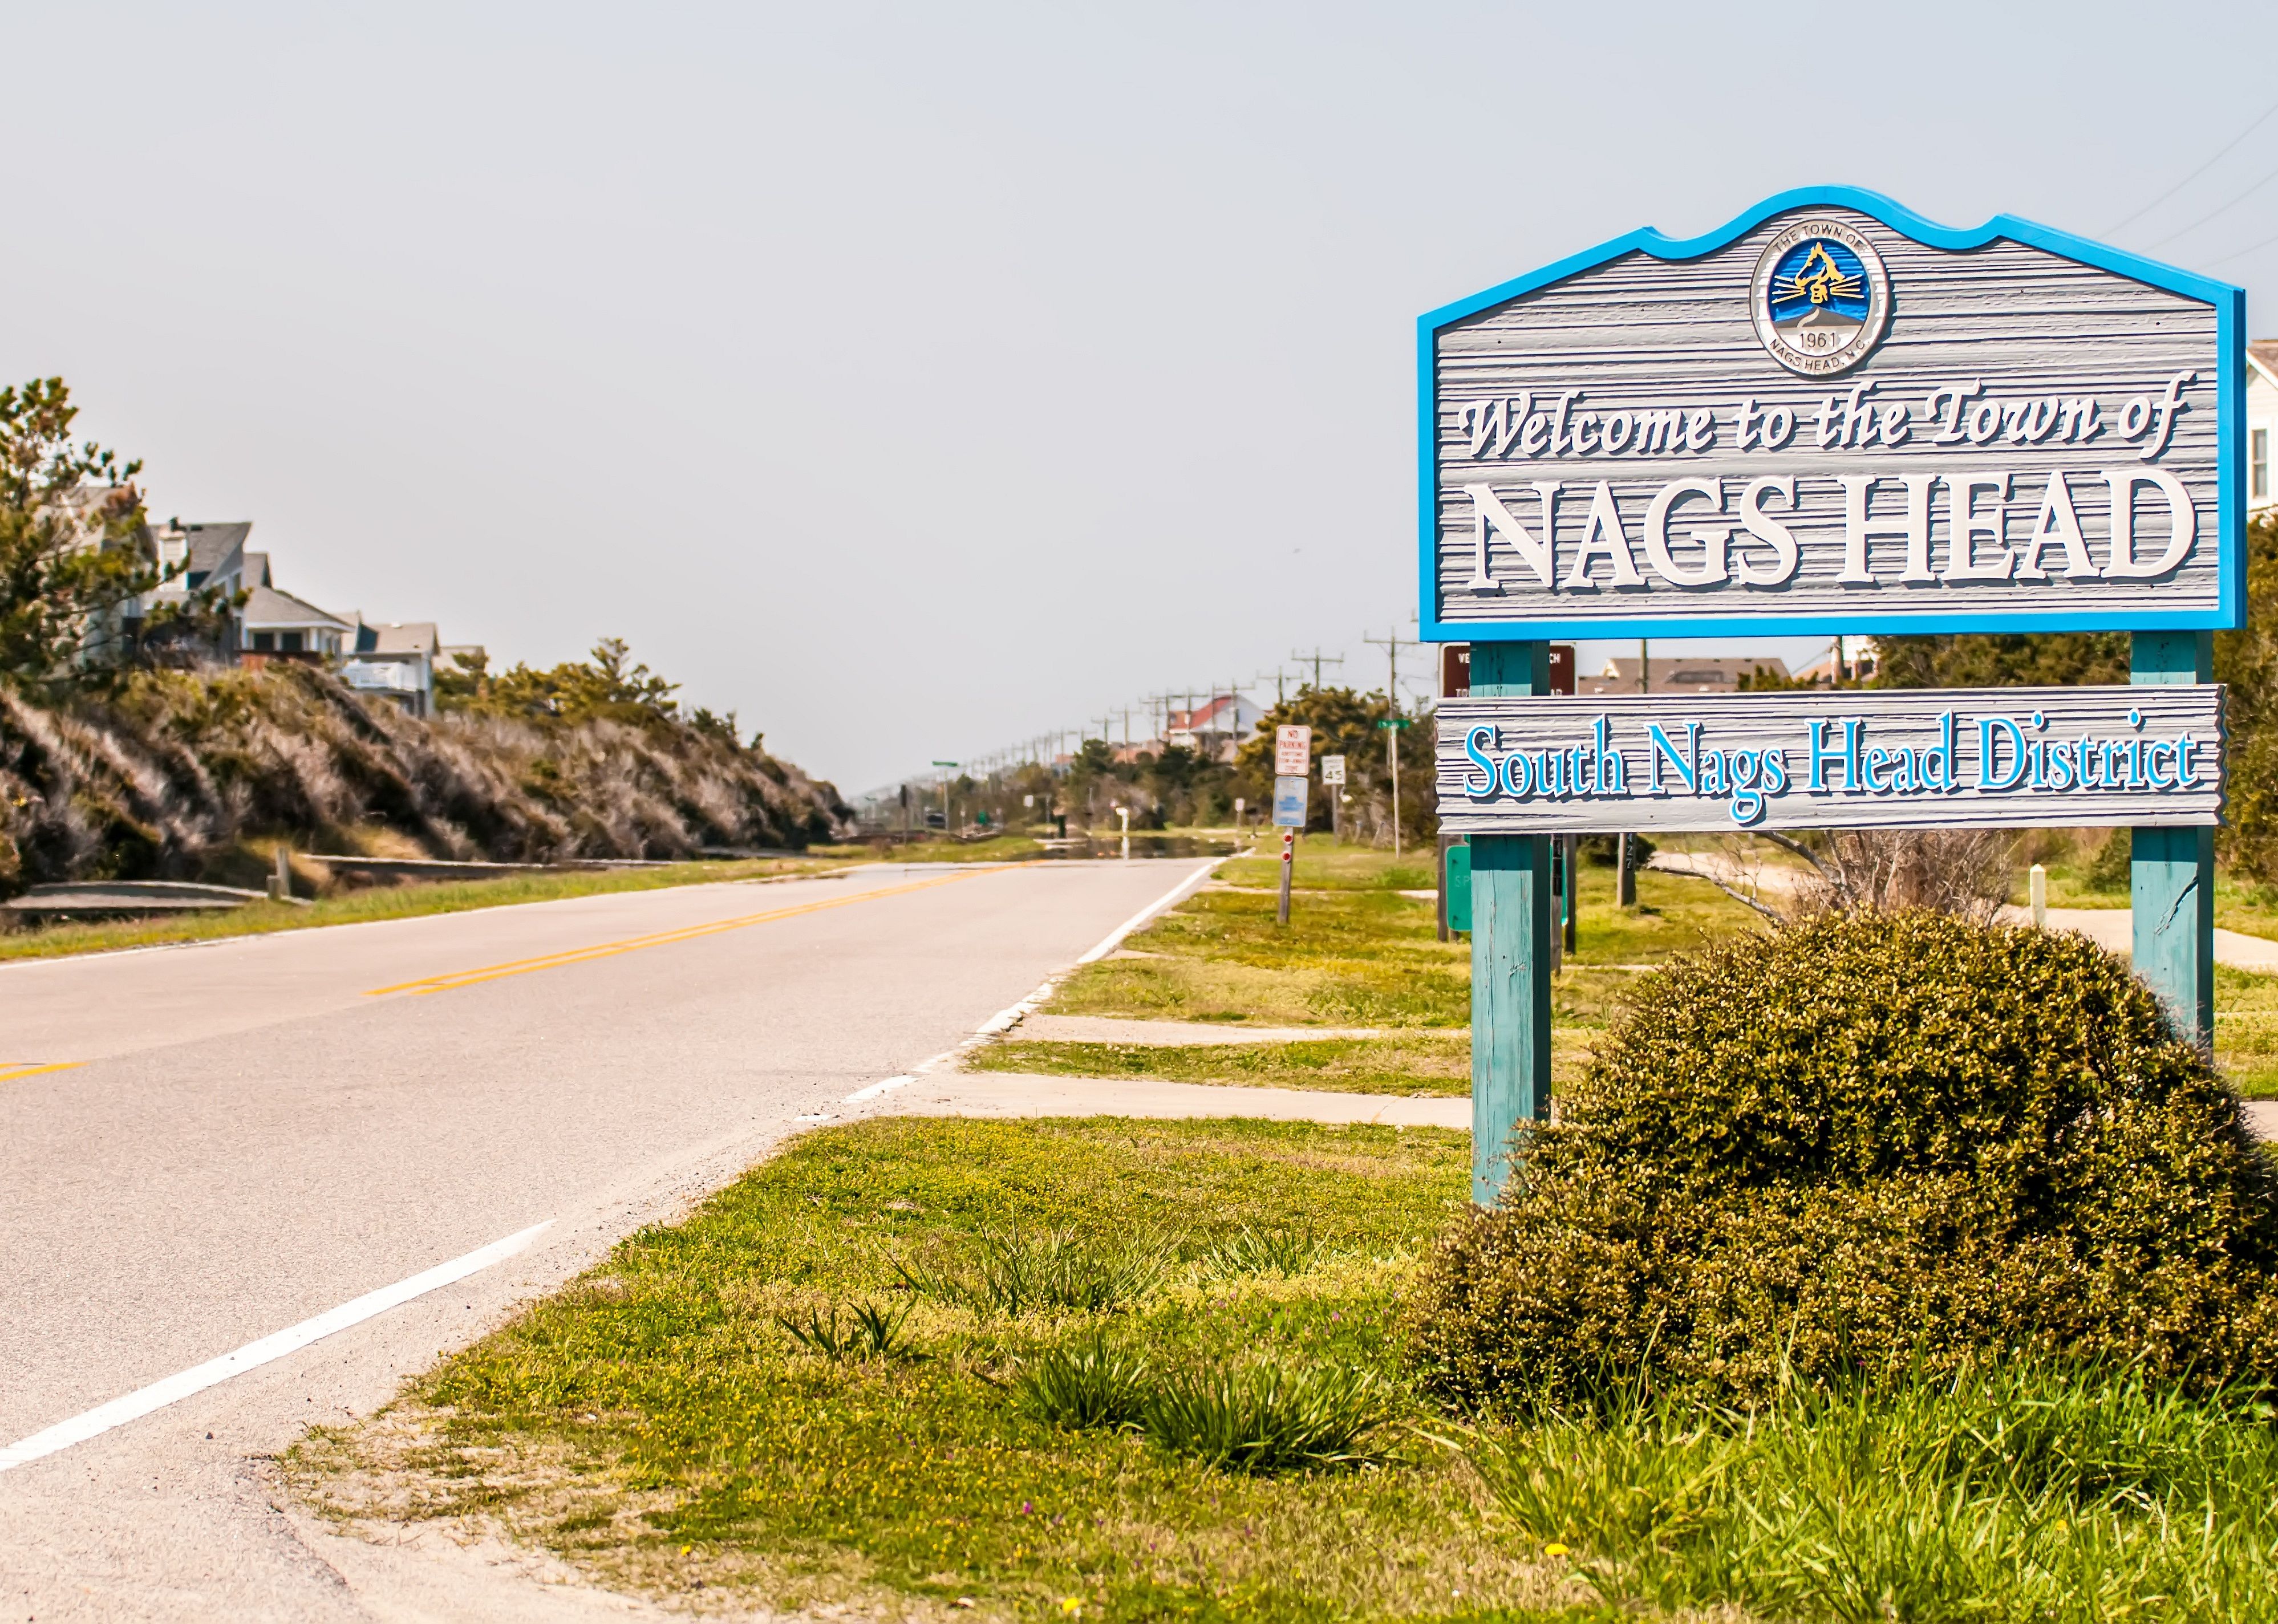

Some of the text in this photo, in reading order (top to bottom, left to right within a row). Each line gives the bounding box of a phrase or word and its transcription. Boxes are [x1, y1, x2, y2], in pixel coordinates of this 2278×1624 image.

[1773, 224, 1865, 252] THE TOWN OF
[1770, 338, 1802, 367] NAGS
[1805, 356, 1845, 371] HEAD,
[1799, 332, 1837, 348] 1961
[1457, 370, 2198, 459] Welcome to the Town of
[1463, 468, 2195, 590] NAGS HEAD
[1325, 770, 1342, 780] 45
[1463, 707, 2200, 825] South Nags Head District
